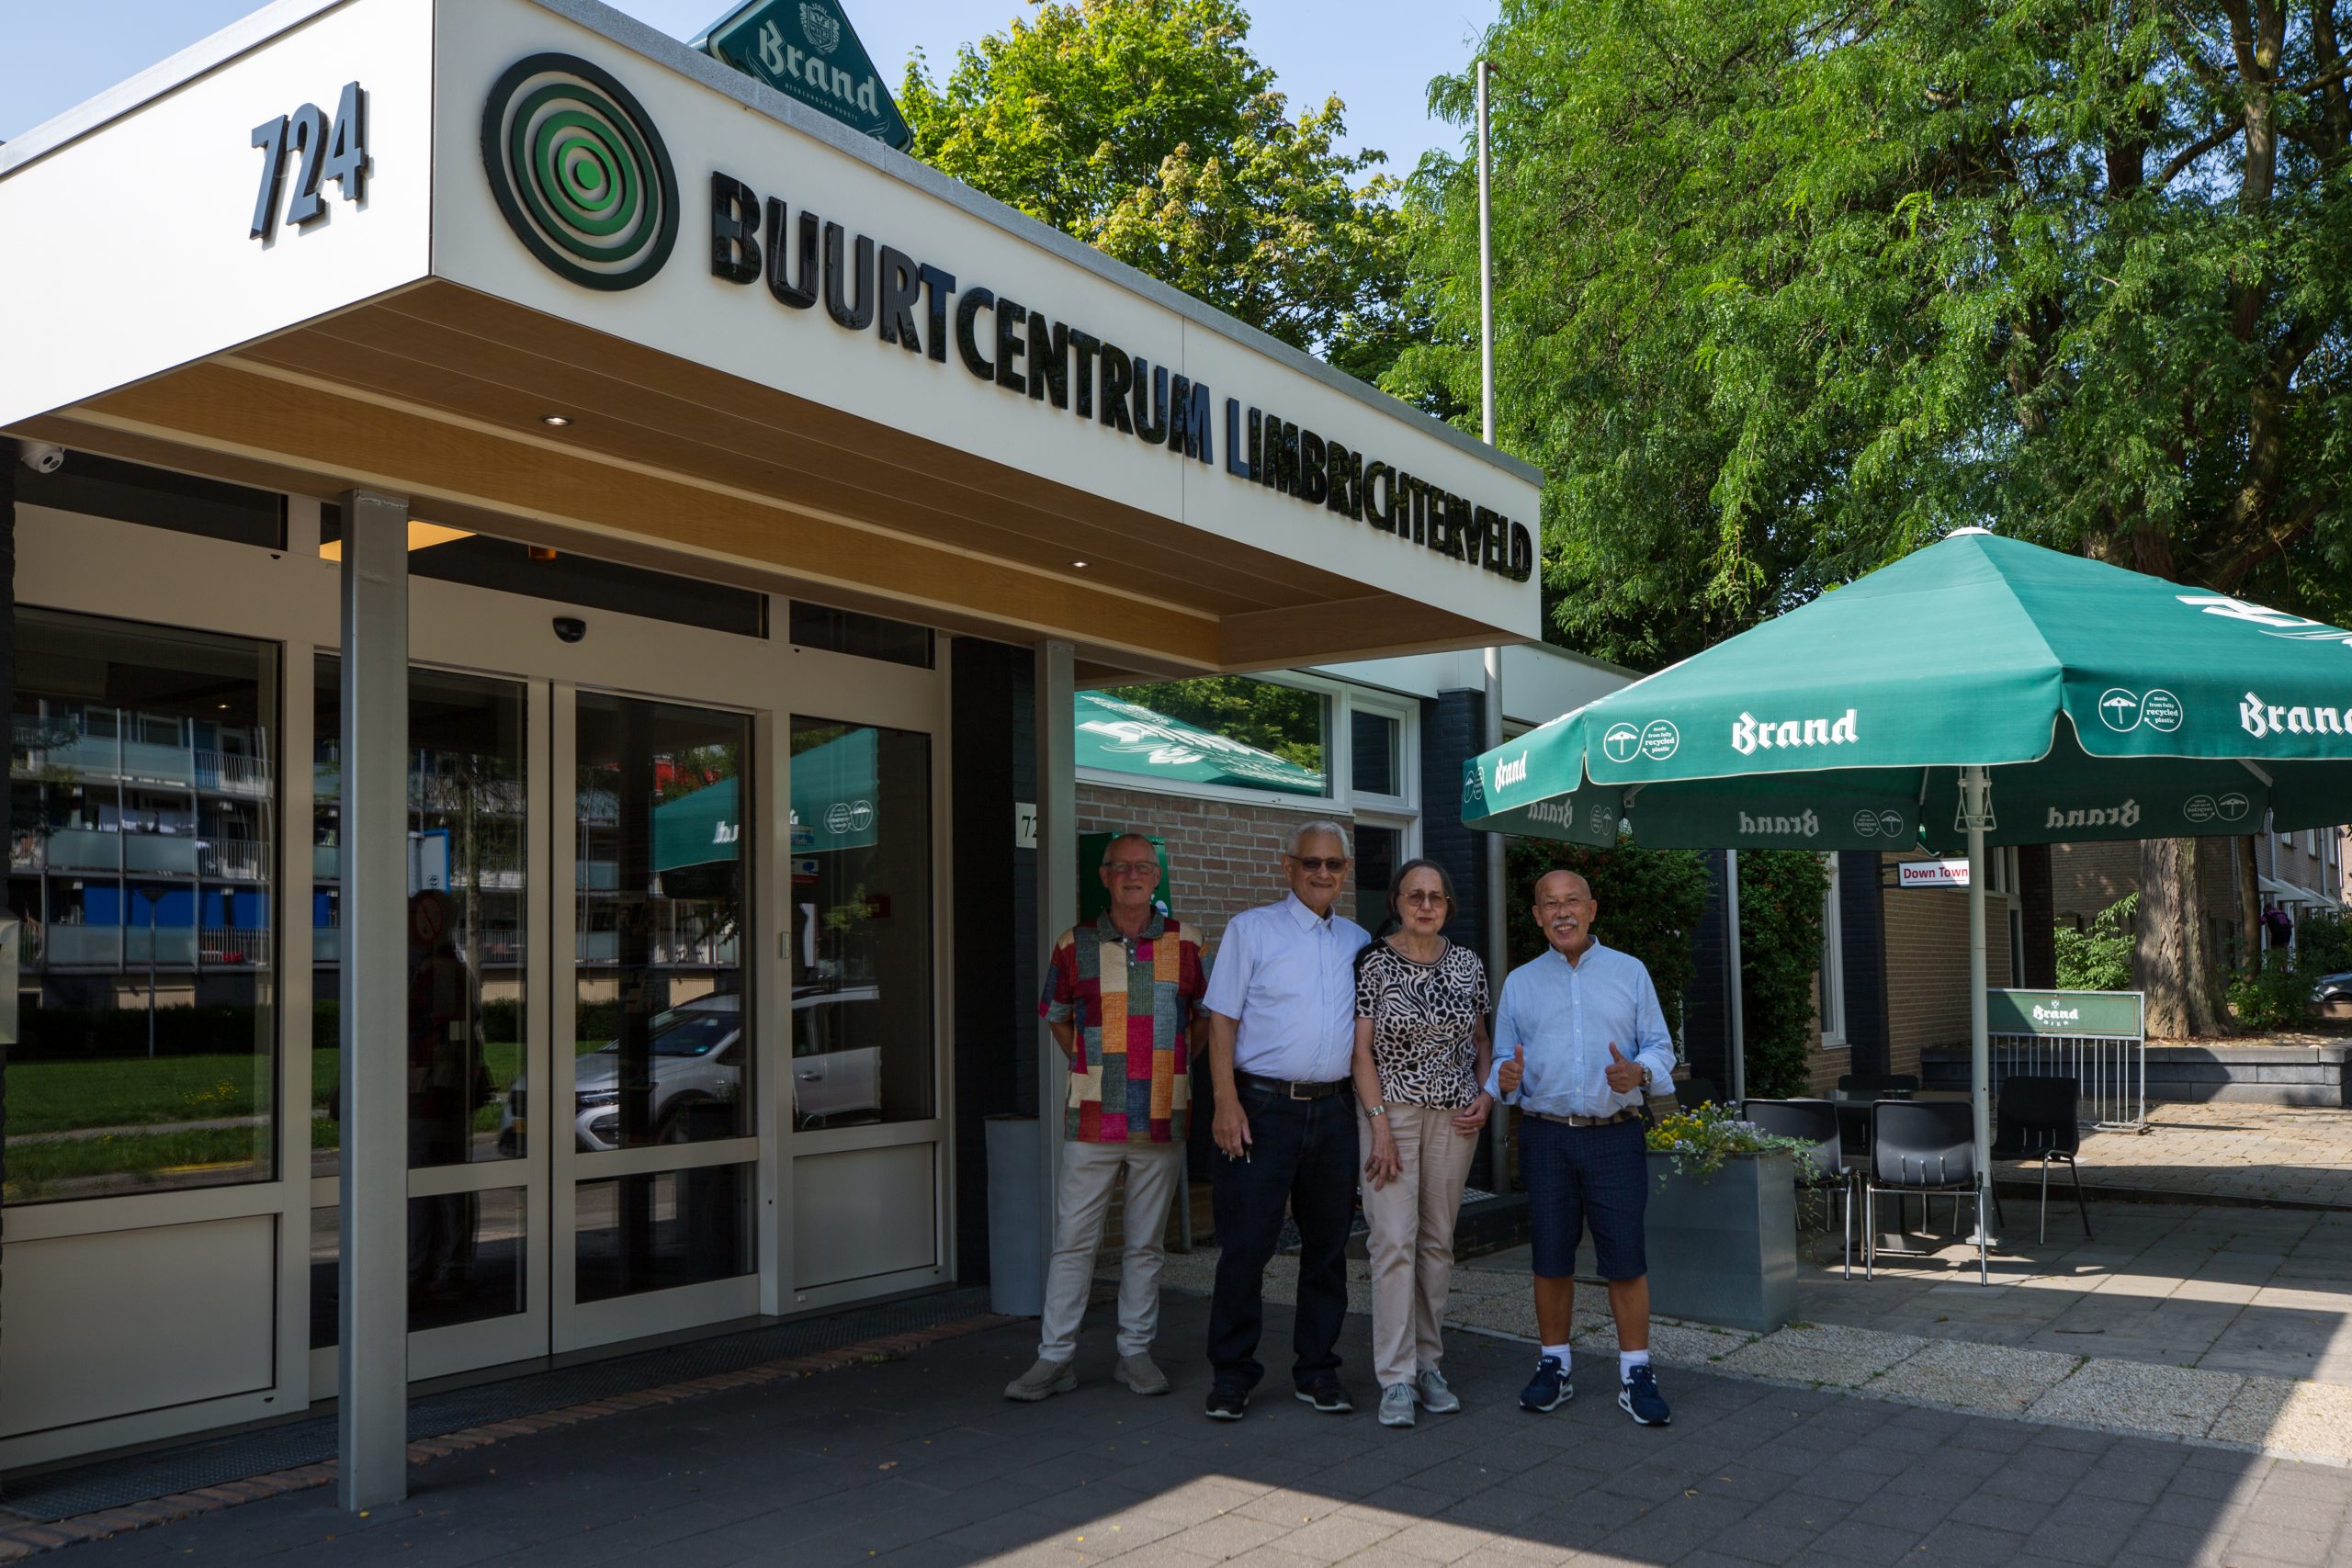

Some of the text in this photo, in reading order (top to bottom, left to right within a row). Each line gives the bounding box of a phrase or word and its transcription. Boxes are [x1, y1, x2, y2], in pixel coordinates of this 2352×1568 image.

[759, 19, 879, 118] Brand
[249, 81, 368, 241] 724
[711, 170, 1532, 583] BUURTCENTRUM LIMBRICHTERVELD
[1645, 737, 1675, 746] recycled
[1731, 707, 1860, 756] Brand
[1495, 750, 1528, 794] Brand
[1904, 866, 1968, 879] Down Town
[2032, 1004, 2079, 1021] Brand
